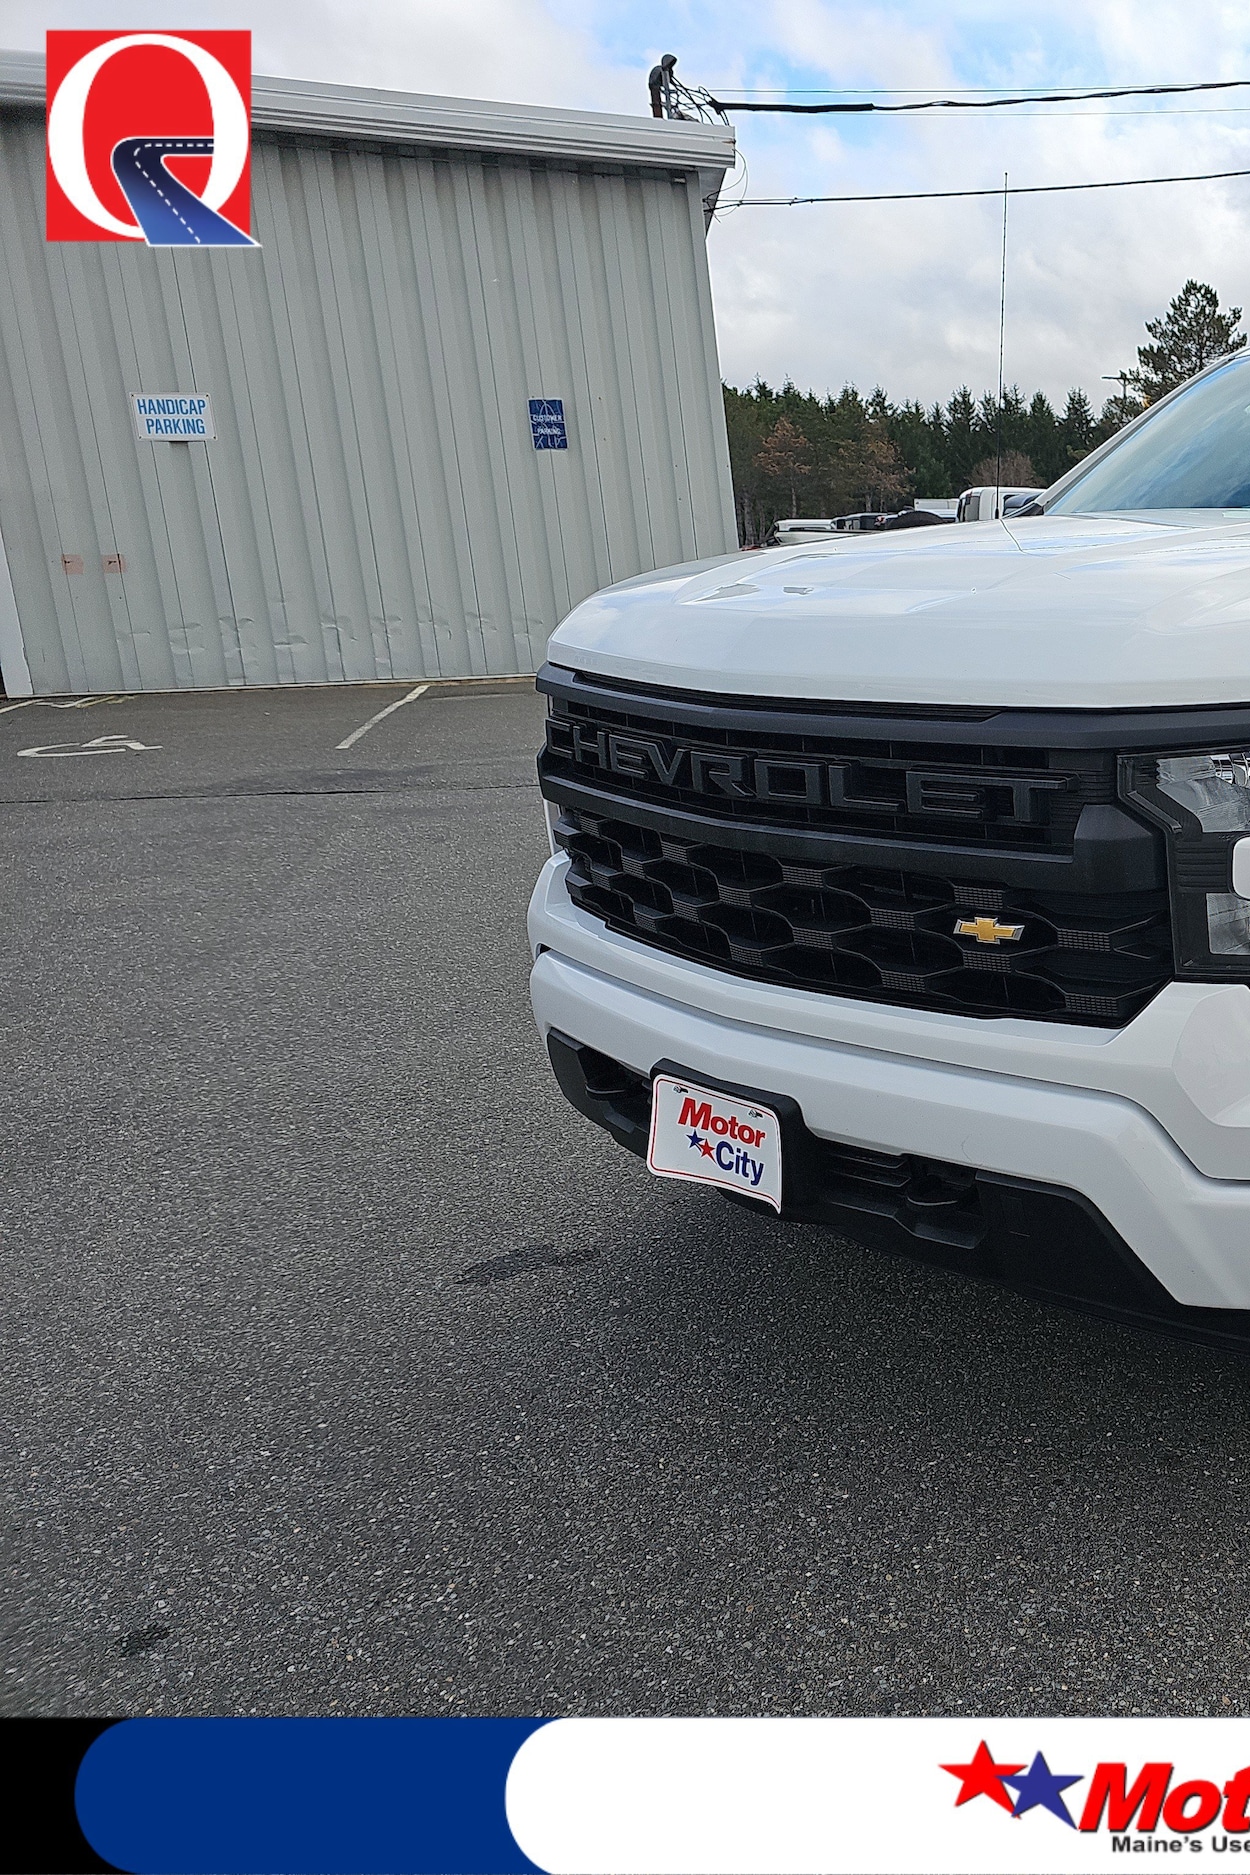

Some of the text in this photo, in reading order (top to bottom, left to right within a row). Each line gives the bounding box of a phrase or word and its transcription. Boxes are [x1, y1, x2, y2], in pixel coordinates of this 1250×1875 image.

[136, 398, 206, 415] HANDICAP
[145, 418, 206, 435] PARKING
[544, 717, 1077, 823] CHEVROLET
[677, 1096, 766, 1148] Motor
[715, 1140, 765, 1186] City
